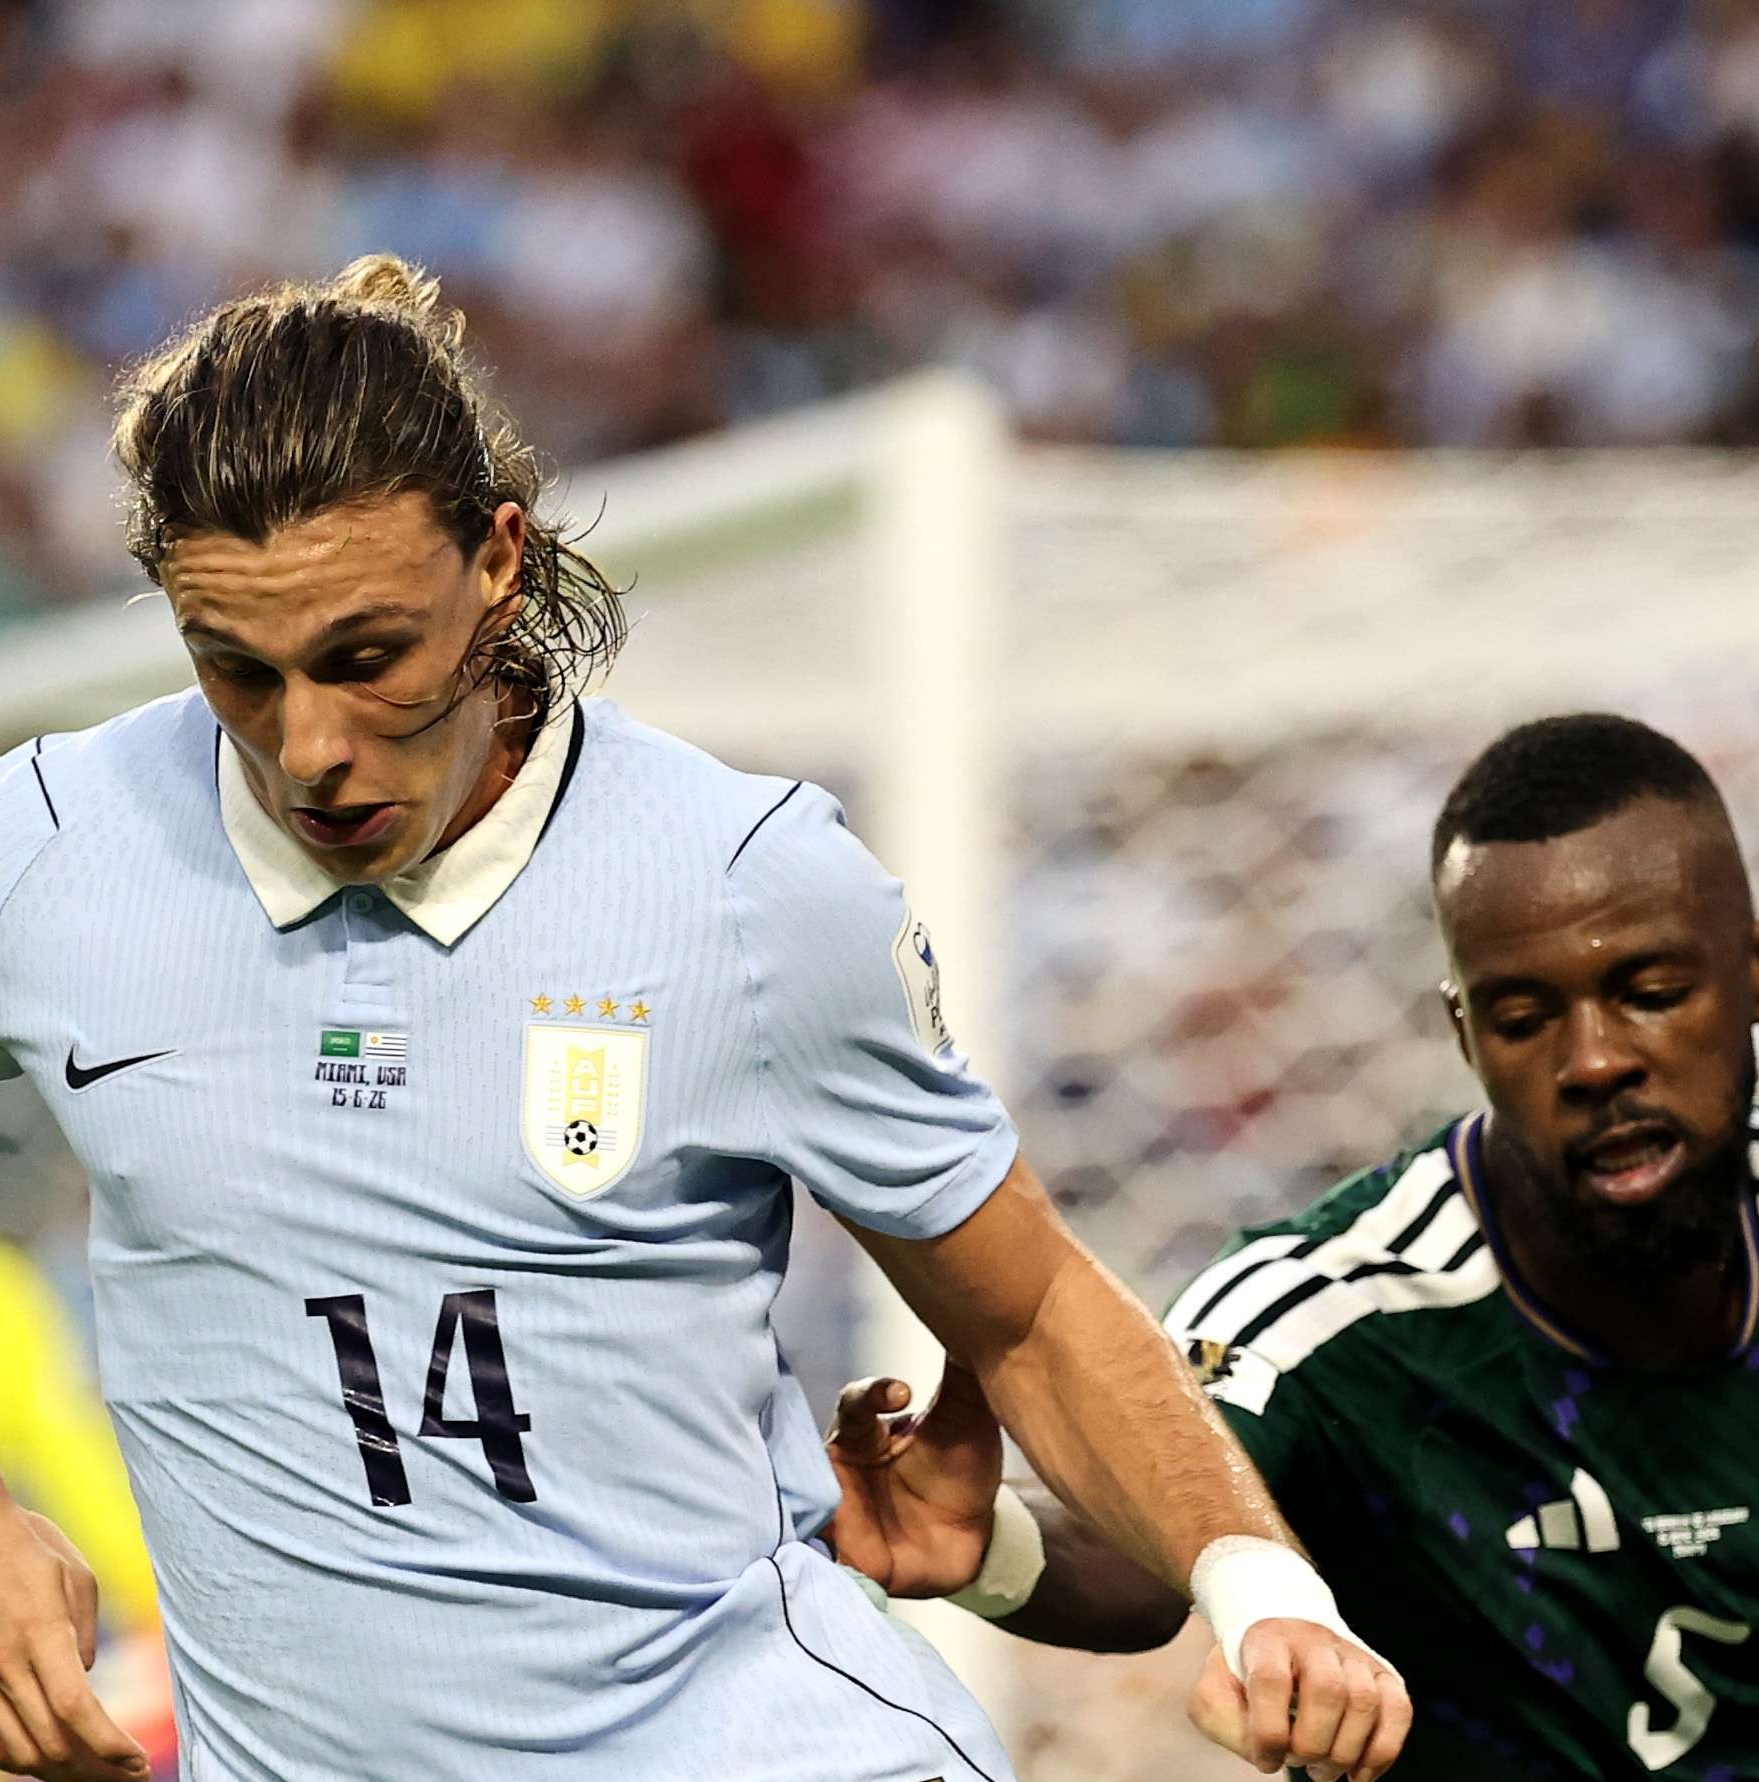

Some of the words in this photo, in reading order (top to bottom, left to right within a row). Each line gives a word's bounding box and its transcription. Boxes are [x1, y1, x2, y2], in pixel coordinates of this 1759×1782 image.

[315, 1061, 370, 1086] MIAMI,
[377, 1066, 406, 1086] USA
[305, 1289, 537, 1508] 14
[1627, 1605, 1751, 1771] 5
